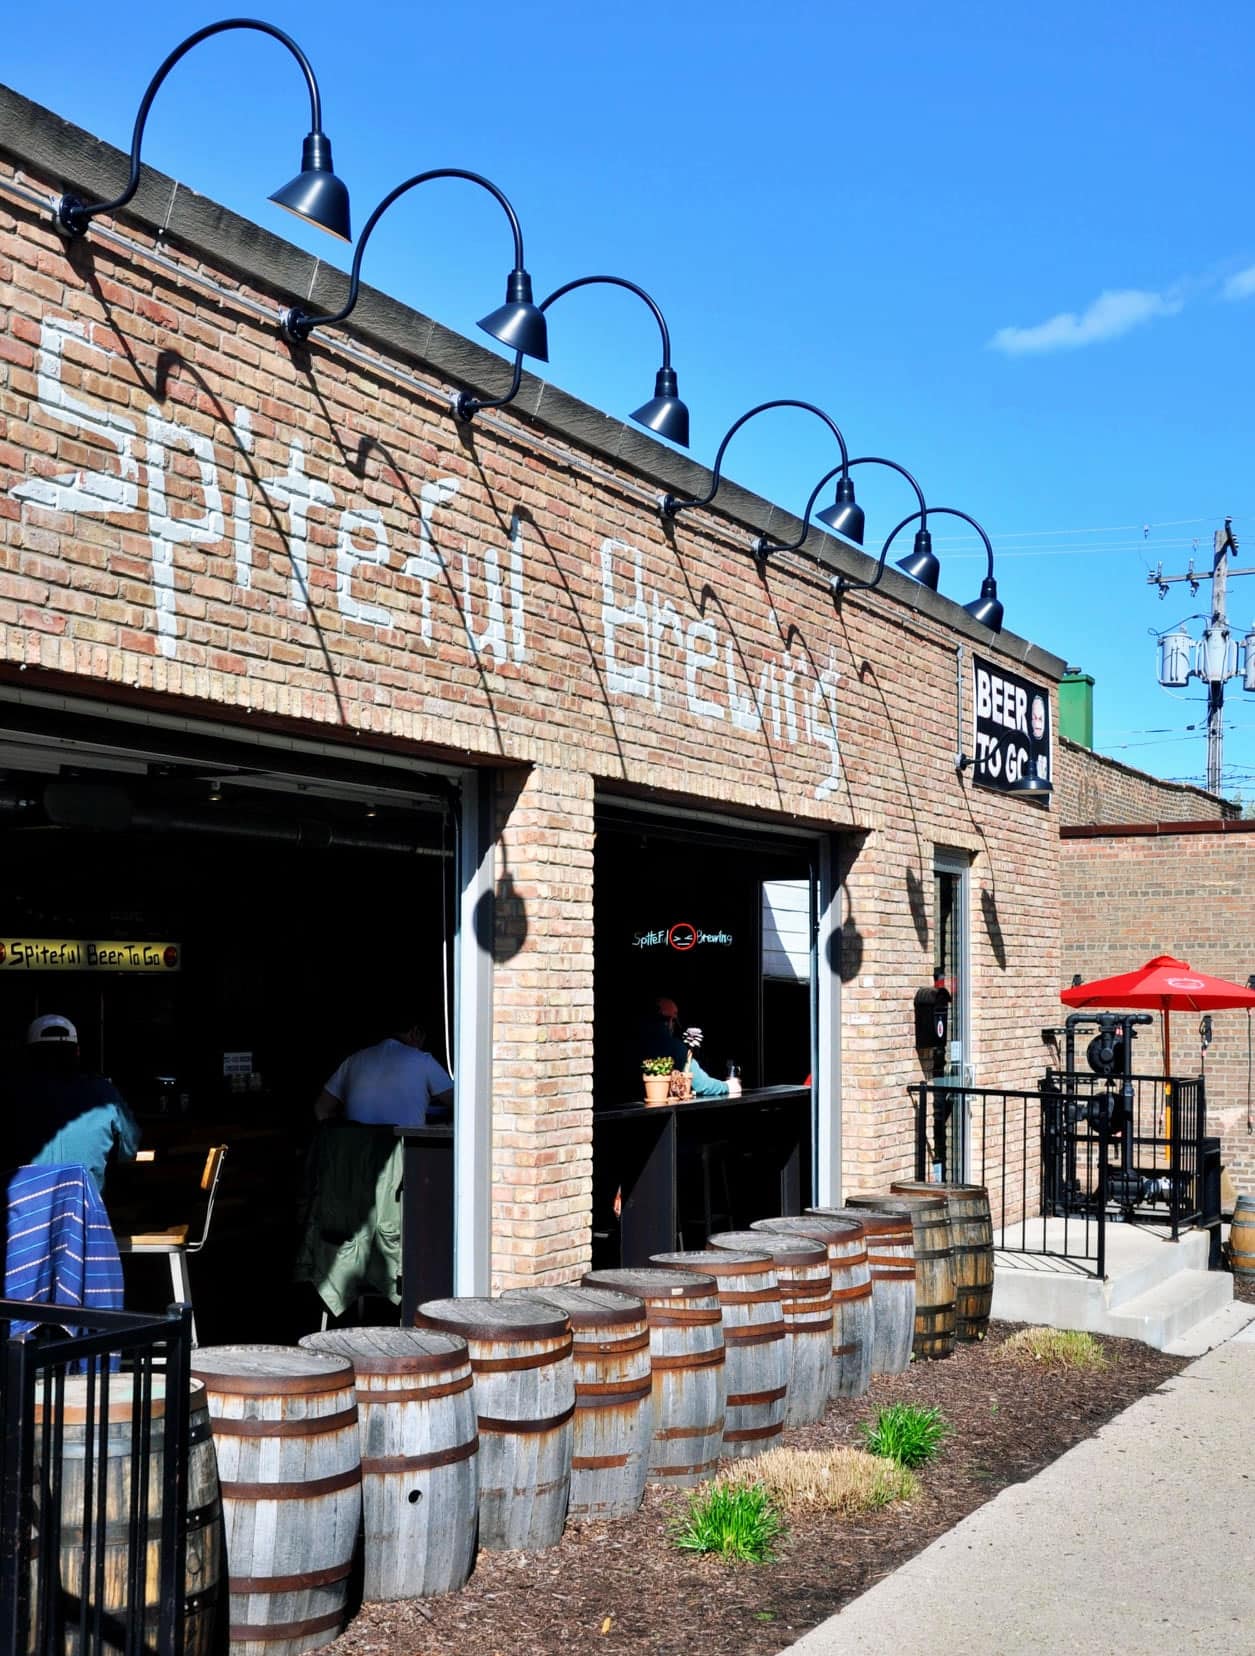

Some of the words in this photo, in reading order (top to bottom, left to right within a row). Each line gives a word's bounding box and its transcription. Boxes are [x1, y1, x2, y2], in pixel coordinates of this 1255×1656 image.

[9, 316, 525, 668] Spiteful
[600, 538, 841, 800] Brewing
[977, 668, 1029, 737] BEER
[977, 732, 1002, 778] TO
[8, 942, 81, 968] Spiteful
[87, 944, 123, 966] Beer
[124, 945, 140, 966] To
[143, 946, 161, 966] Go
[697, 929, 733, 946] Brewing
